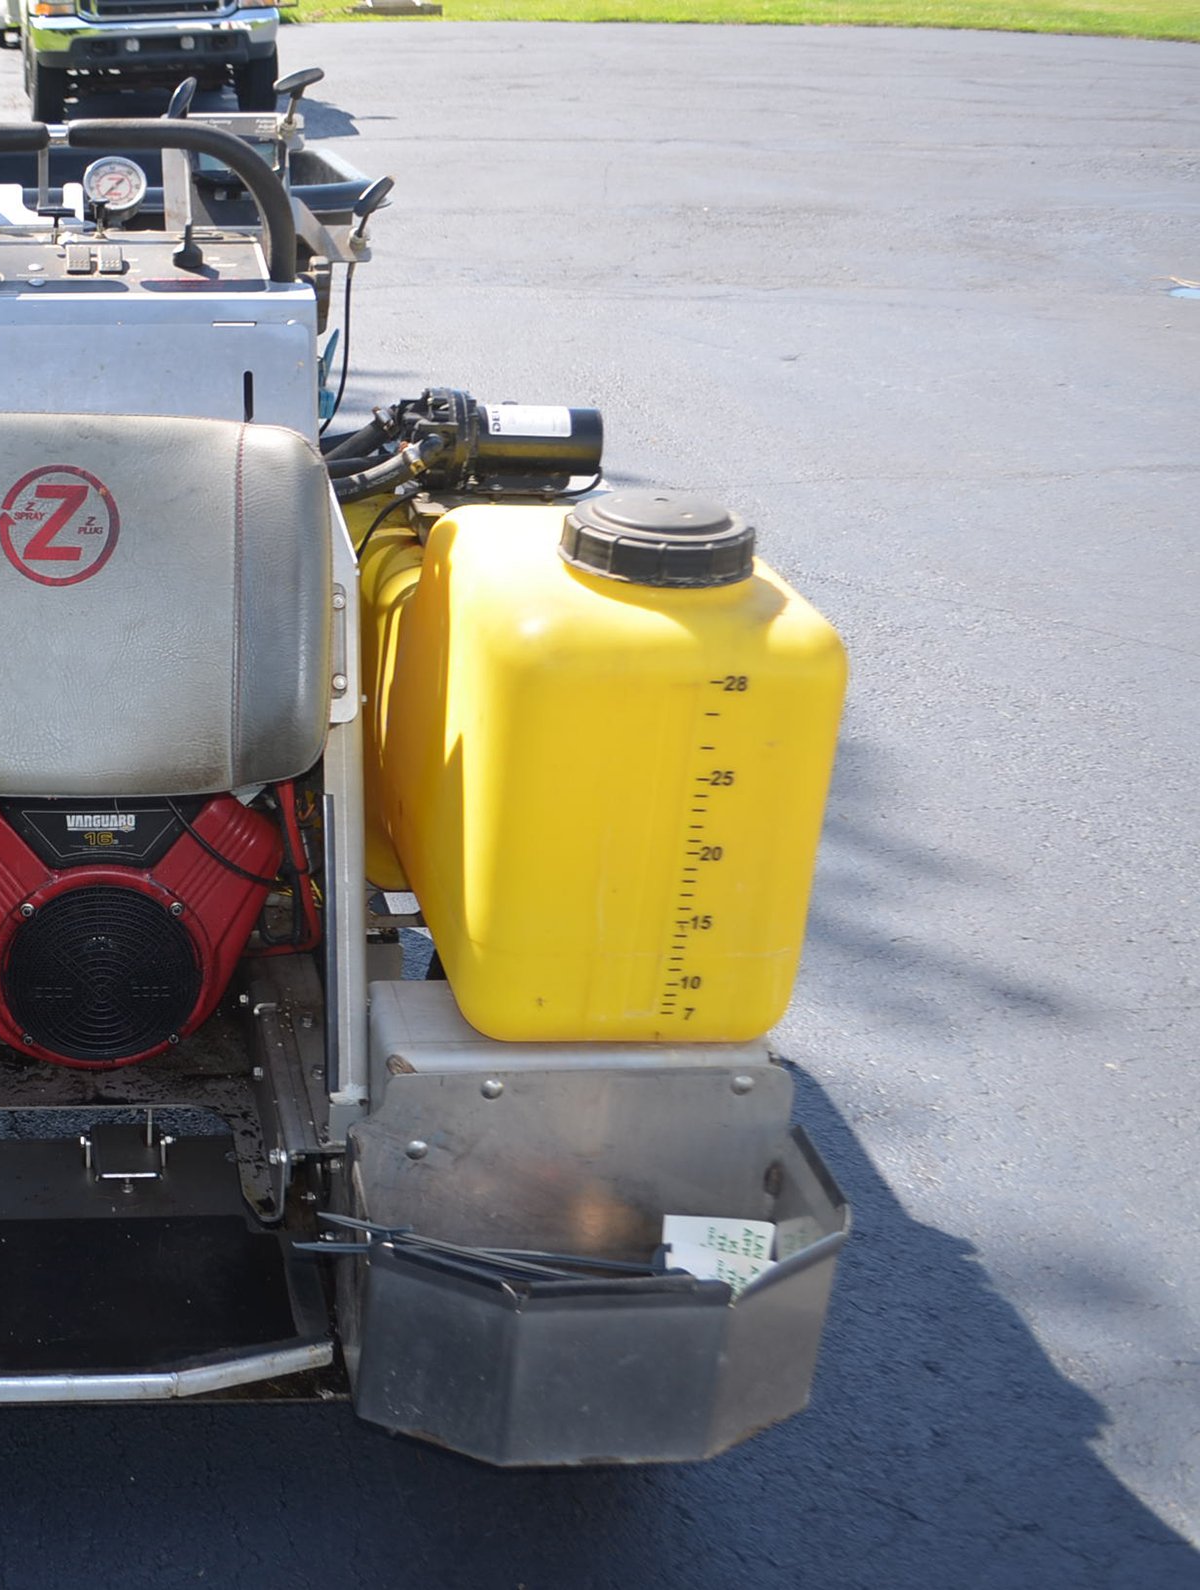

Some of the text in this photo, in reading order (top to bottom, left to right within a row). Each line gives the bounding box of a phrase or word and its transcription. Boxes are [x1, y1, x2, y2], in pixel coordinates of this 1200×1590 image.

[25, 501, 36, 511] Z
[13, 512, 46, 521] SPRAY
[22, 484, 89, 561] Z
[85, 516, 97, 526] Z
[77, 526, 104, 535] PLUG
[723, 676, 748, 693] 28
[709, 770, 735, 787] 25
[65, 814, 136, 828] VANGUARD
[83, 831, 114, 846] 16
[698, 846, 723, 862] 20
[690, 914, 713, 931] 15
[680, 975, 702, 990] 10
[684, 1007, 696, 1021] 7
